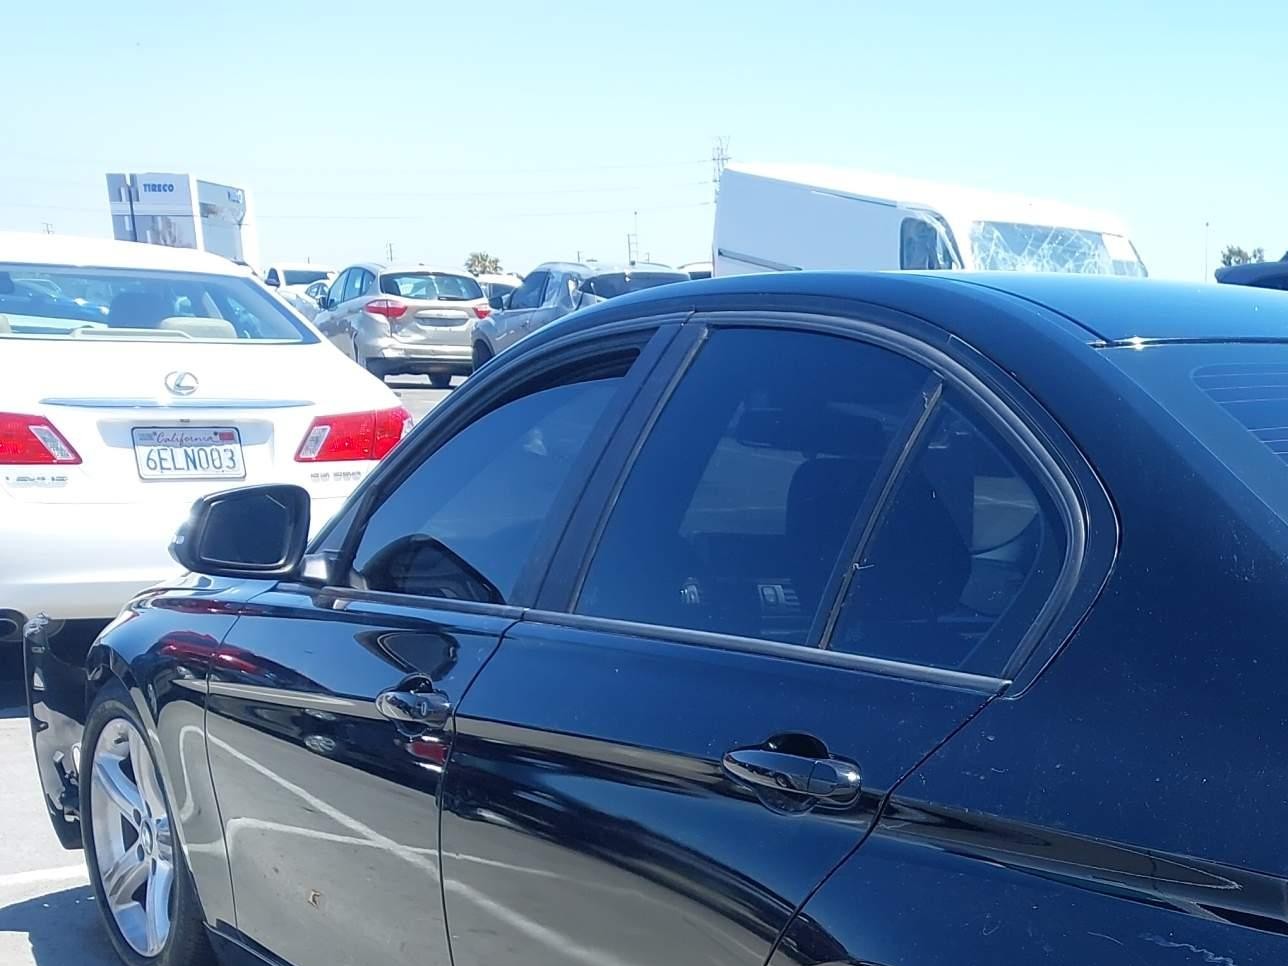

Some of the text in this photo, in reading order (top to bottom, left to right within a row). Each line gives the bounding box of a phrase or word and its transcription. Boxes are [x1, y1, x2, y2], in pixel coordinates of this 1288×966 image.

[143, 183, 175, 193] TIRECO
[155, 431, 220, 446] California
[146, 448, 237, 471] 6ELN003
